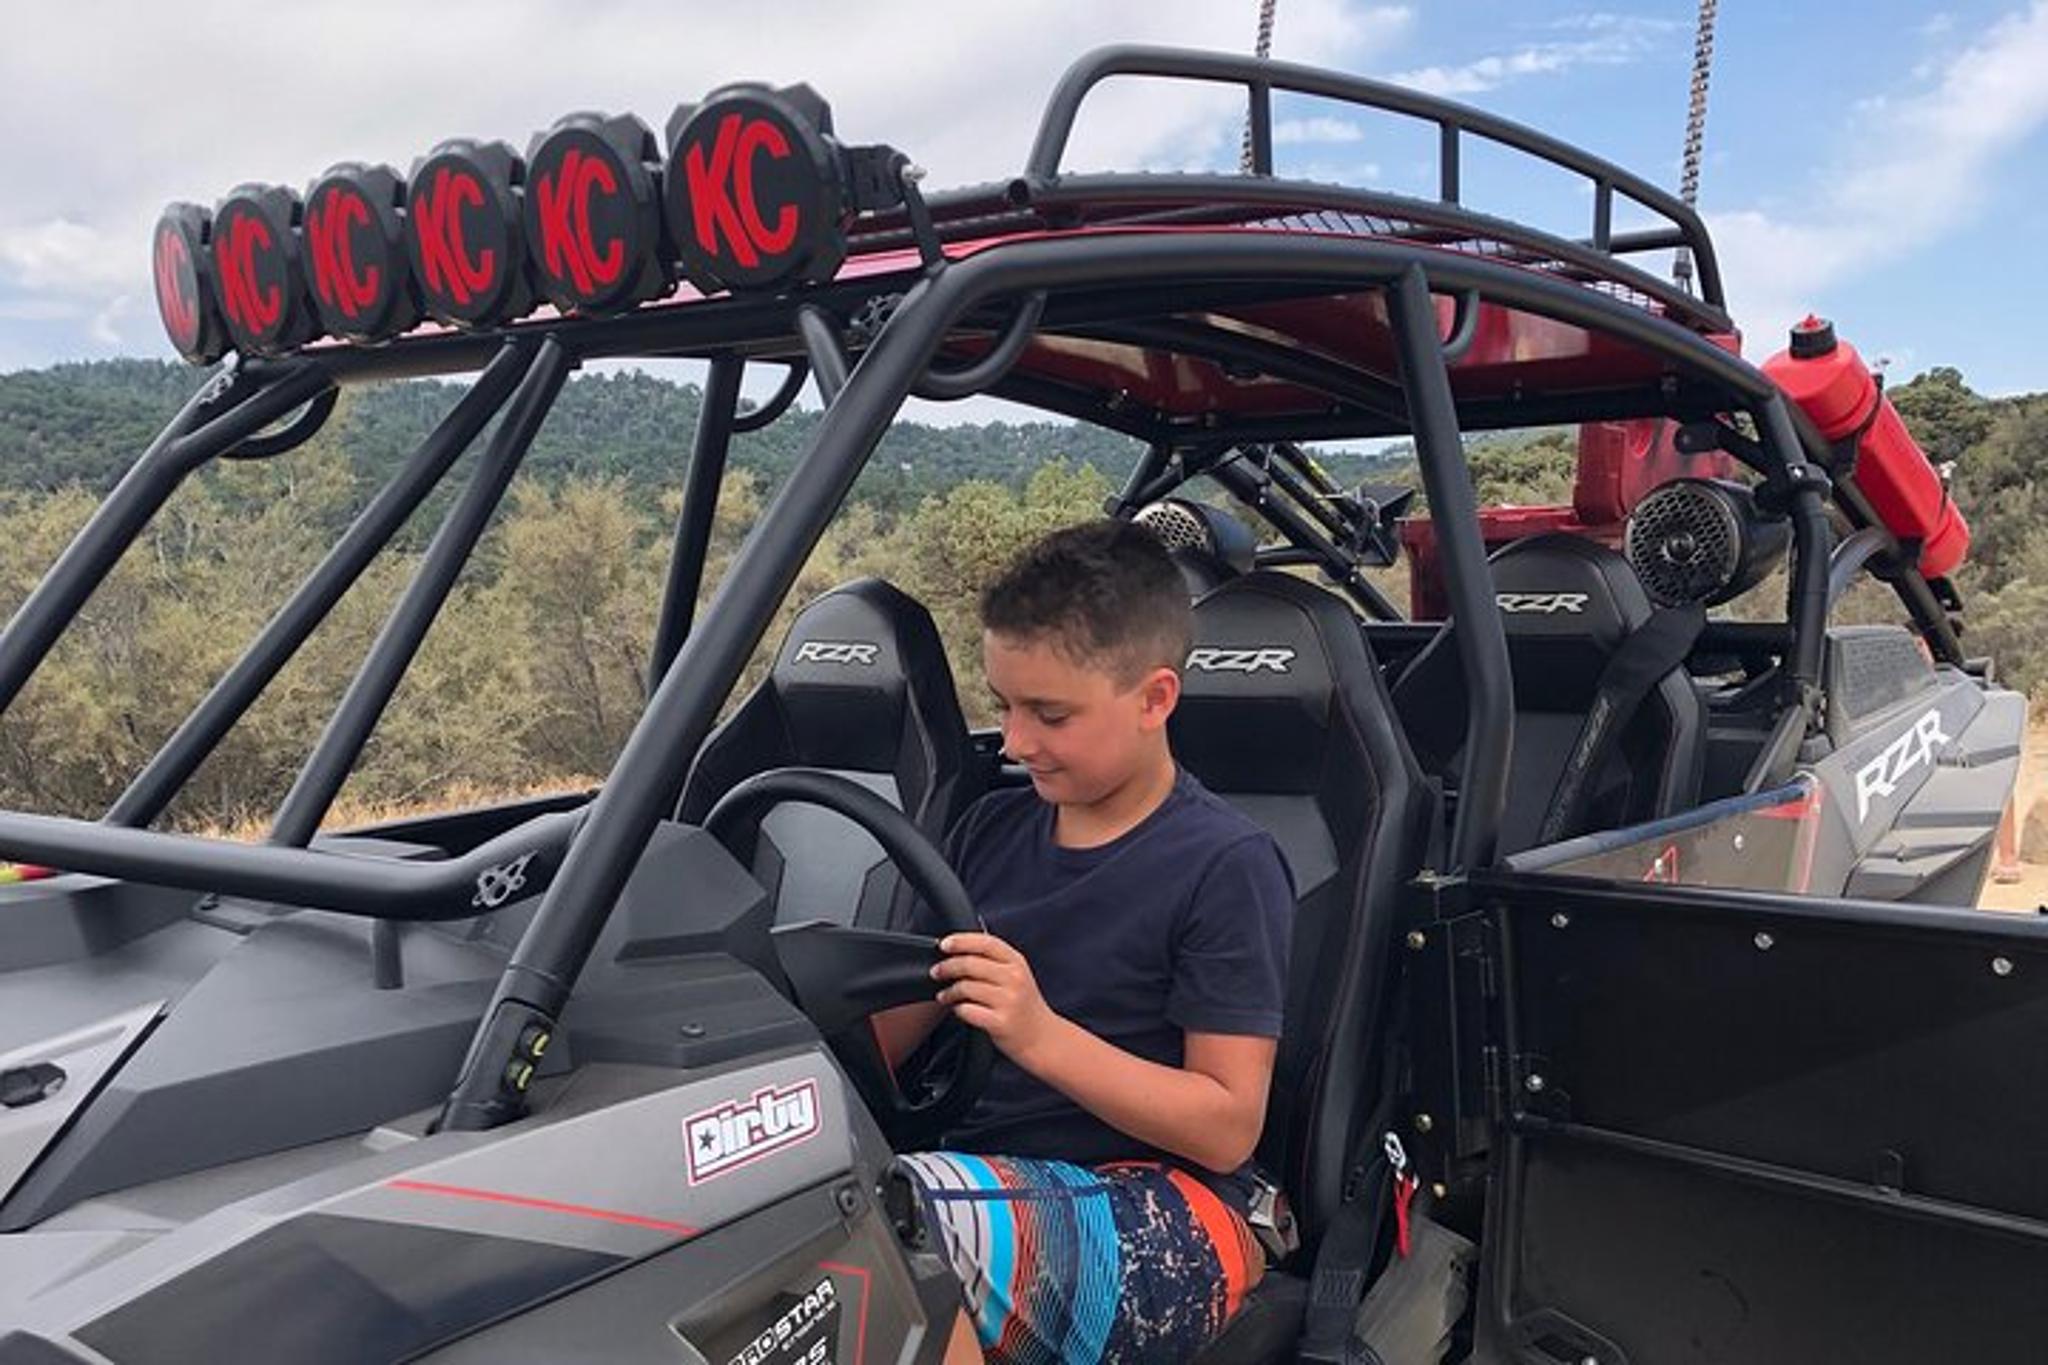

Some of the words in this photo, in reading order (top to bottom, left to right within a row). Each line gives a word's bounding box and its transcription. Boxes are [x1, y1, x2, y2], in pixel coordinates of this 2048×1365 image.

[415, 169, 495, 306] KC
[537, 149, 625, 295] KC
[684, 114, 800, 269] KC
[217, 214, 281, 334] KC
[309, 188, 379, 316] KC
[793, 641, 878, 663] RZR
[1184, 647, 1296, 672] RZR
[1856, 708, 1951, 824] RZR
[690, 1086, 816, 1168] Dirty
